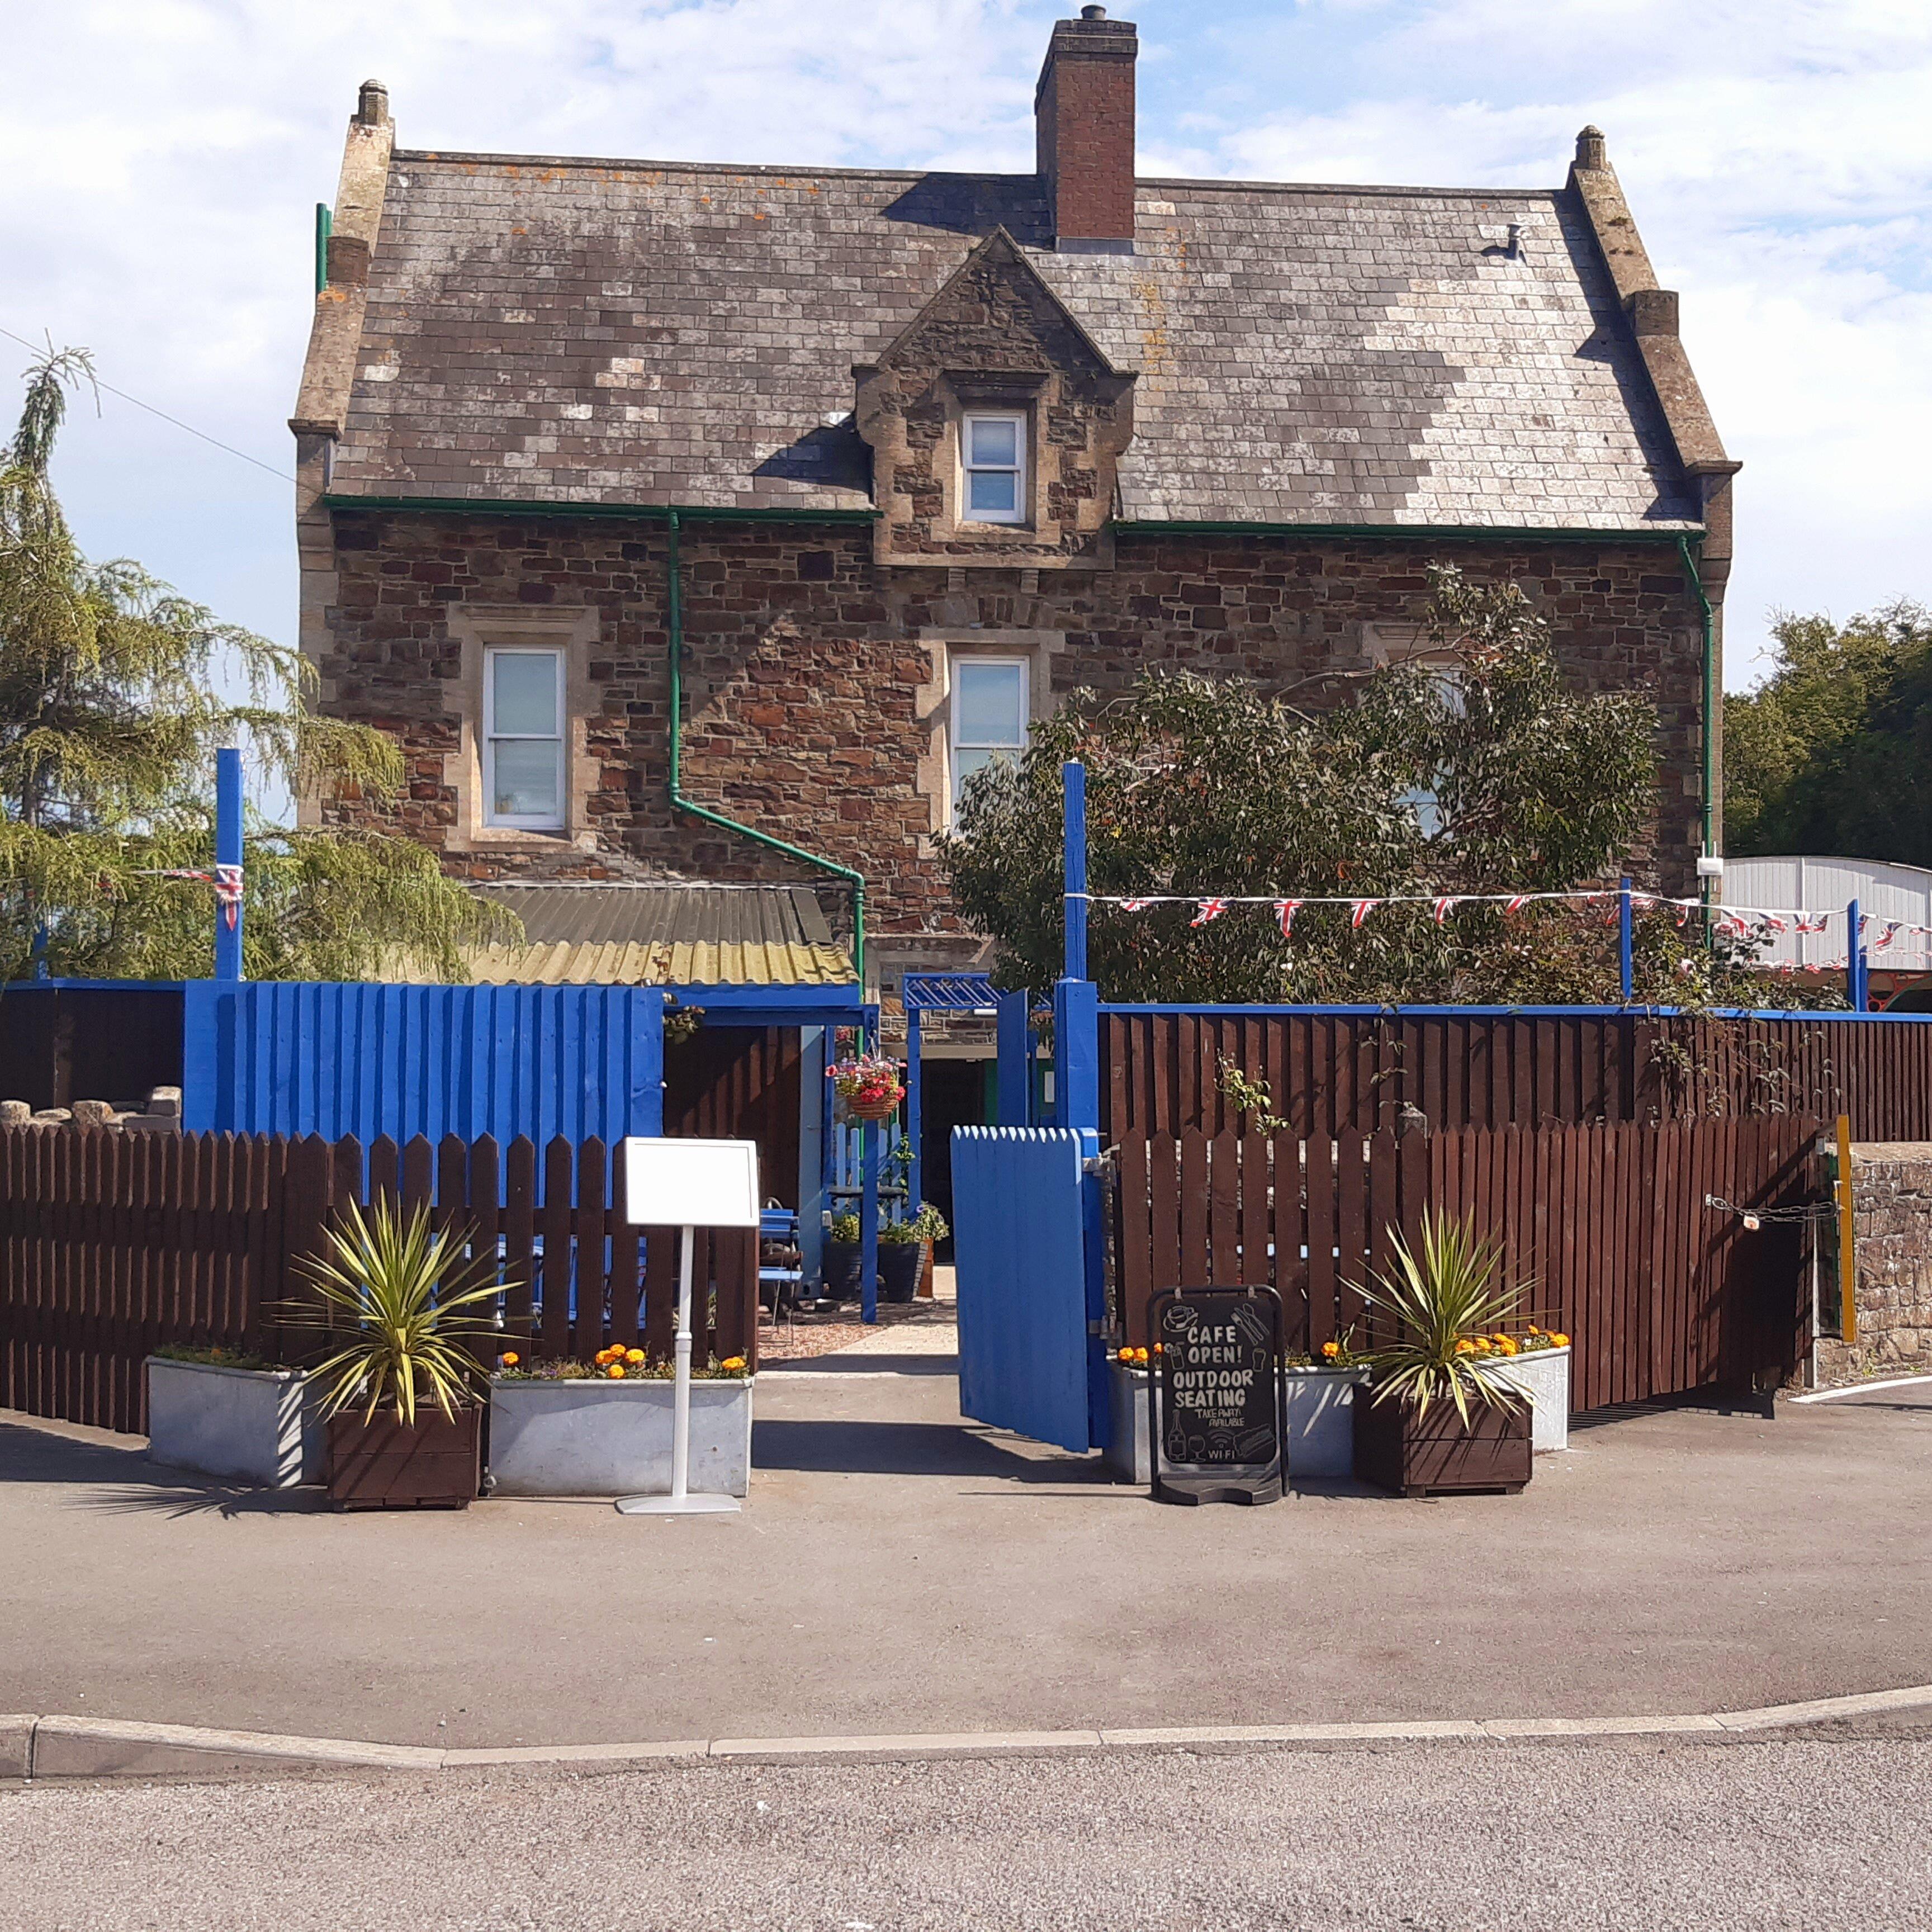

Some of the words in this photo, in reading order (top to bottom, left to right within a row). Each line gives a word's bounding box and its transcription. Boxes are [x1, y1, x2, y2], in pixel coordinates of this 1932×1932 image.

[1187, 1325, 1236, 1344] CAFE
[1188, 1345, 1242, 1364] OPEN!
[1173, 1369, 1253, 1389] OUTDOOR
[1175, 1389, 1246, 1408] SEATING
[1195, 1408, 1217, 1418] TAKE
